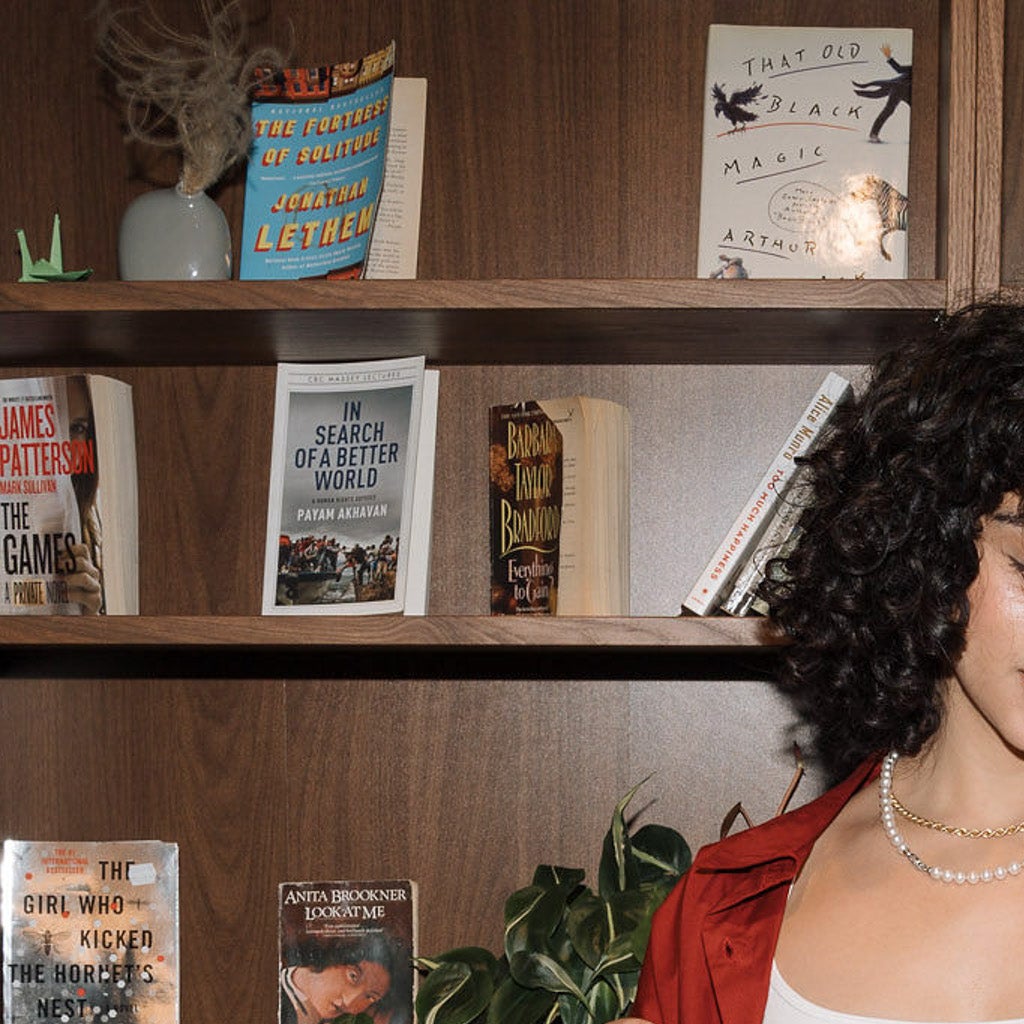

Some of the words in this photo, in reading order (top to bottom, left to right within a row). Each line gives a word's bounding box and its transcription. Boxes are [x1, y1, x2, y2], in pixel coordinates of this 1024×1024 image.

[742, 49, 805, 76] THAT
[822, 43, 861, 59] OLD
[255, 119, 297, 138] THE
[302, 95, 390, 137] FORTRESS
[766, 95, 863, 119] BLACK
[261, 148, 290, 167] OF
[296, 126, 382, 166] SOLITUDE
[723, 146, 823, 176] MAGIC
[271, 175, 369, 213] JONATHAN
[254, 203, 374, 252] LETHEM
[722, 229, 817, 255] ARTHUR
[0, 403, 54, 440] JAMES
[343, 401, 362, 422] IN
[806, 394, 836, 424] Alice
[315, 421, 384, 446] SEARCH
[783, 424, 814, 461] Munro
[0, 438, 95, 477] PATTERSON
[295, 448, 318, 469] OF
[318, 447, 331, 468] A
[337, 442, 399, 467] BETTER
[314, 467, 378, 491] WORLD
[514, 463, 552, 501] TAYLOR
[767, 468, 785, 491] TOO
[1, 502, 30, 530] THE
[297, 508, 335, 521] PAYAM
[337, 504, 388, 520] AKHAVAN
[747, 491, 769, 523] MUCH
[3, 532, 77, 575] GAMES
[710, 523, 749, 580] HAPPINESS
[514, 584, 526, 600] to
[23, 895, 68, 915] GIRL
[79, 895, 124, 915] WHO
[284, 889, 328, 905] ANITA
[331, 888, 407, 904] BROOKNER
[305, 906, 341, 921] LOOK
[342, 906, 361, 918] AT
[362, 905, 385, 920] ME
[80, 929, 153, 949] KICKED
[8, 963, 45, 983] THE
[55, 963, 154, 984] HORNET'S
[38, 998, 87, 1018] NEST
